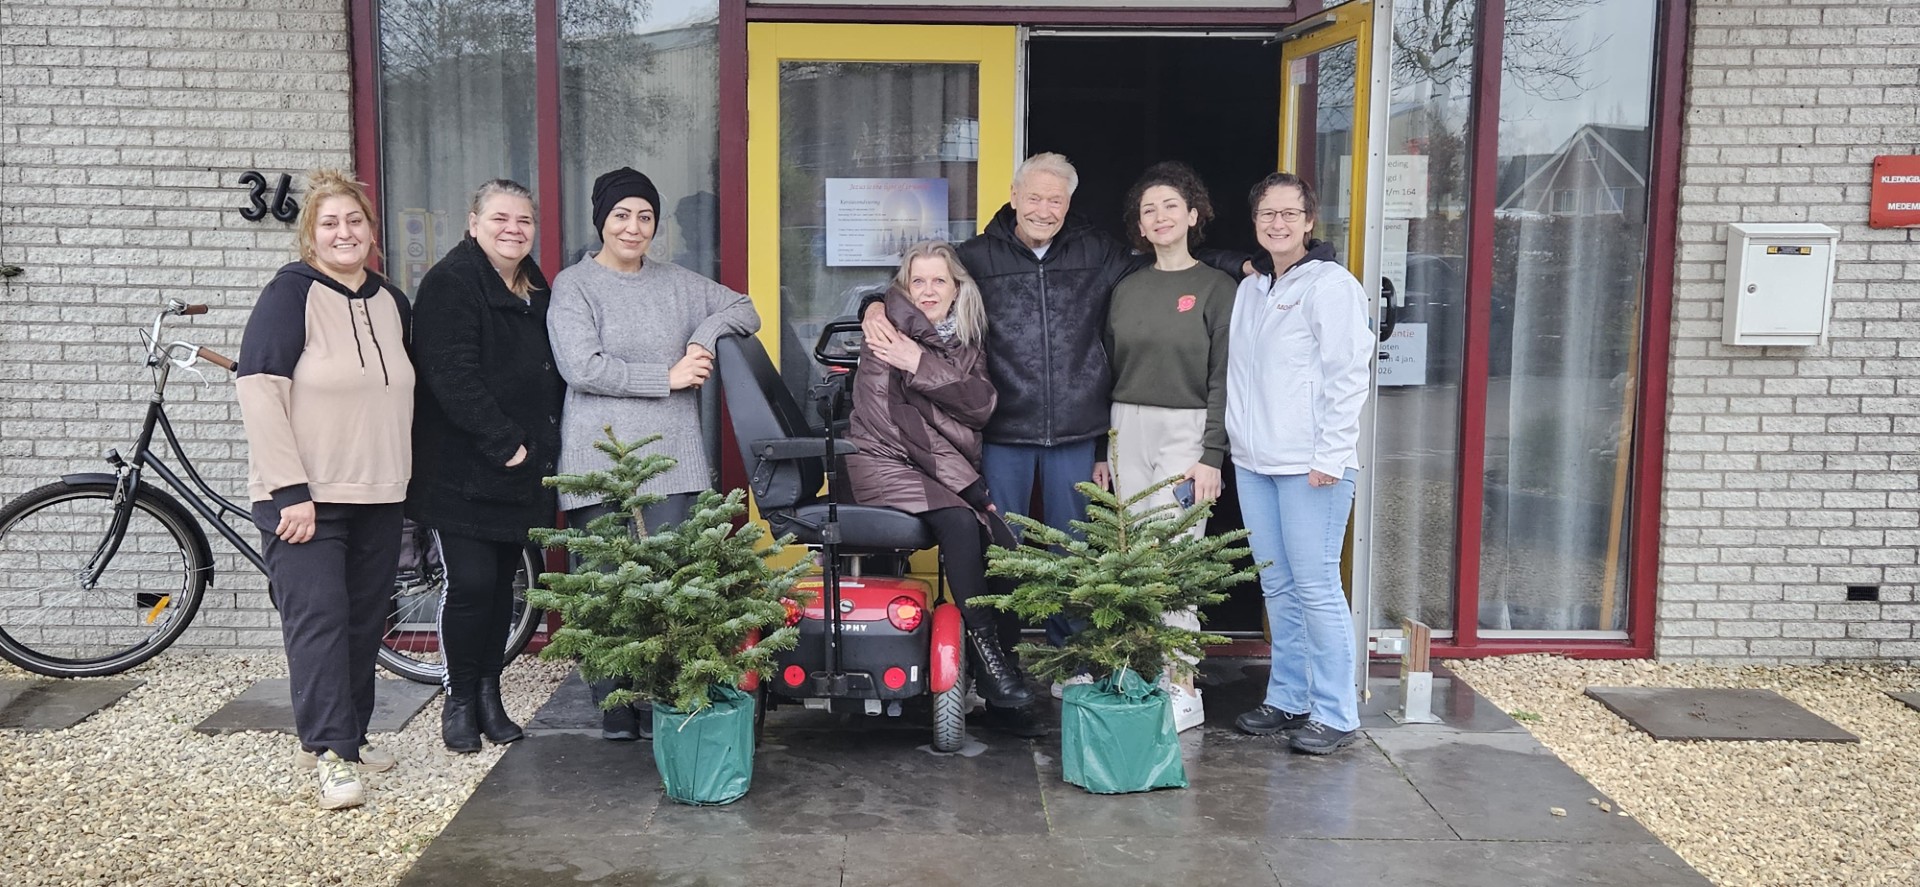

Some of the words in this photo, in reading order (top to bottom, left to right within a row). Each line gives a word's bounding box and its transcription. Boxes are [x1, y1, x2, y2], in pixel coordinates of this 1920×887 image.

[1387, 161, 1408, 169] eding
[1881, 175, 1920, 184] KLEDINGB
[1402, 188, 1416, 196] 164
[238, 171, 299, 223] 36
[1392, 329, 1415, 338] antie
[1401, 356, 1415, 364] jan.
[1378, 367, 1392, 375] 026
